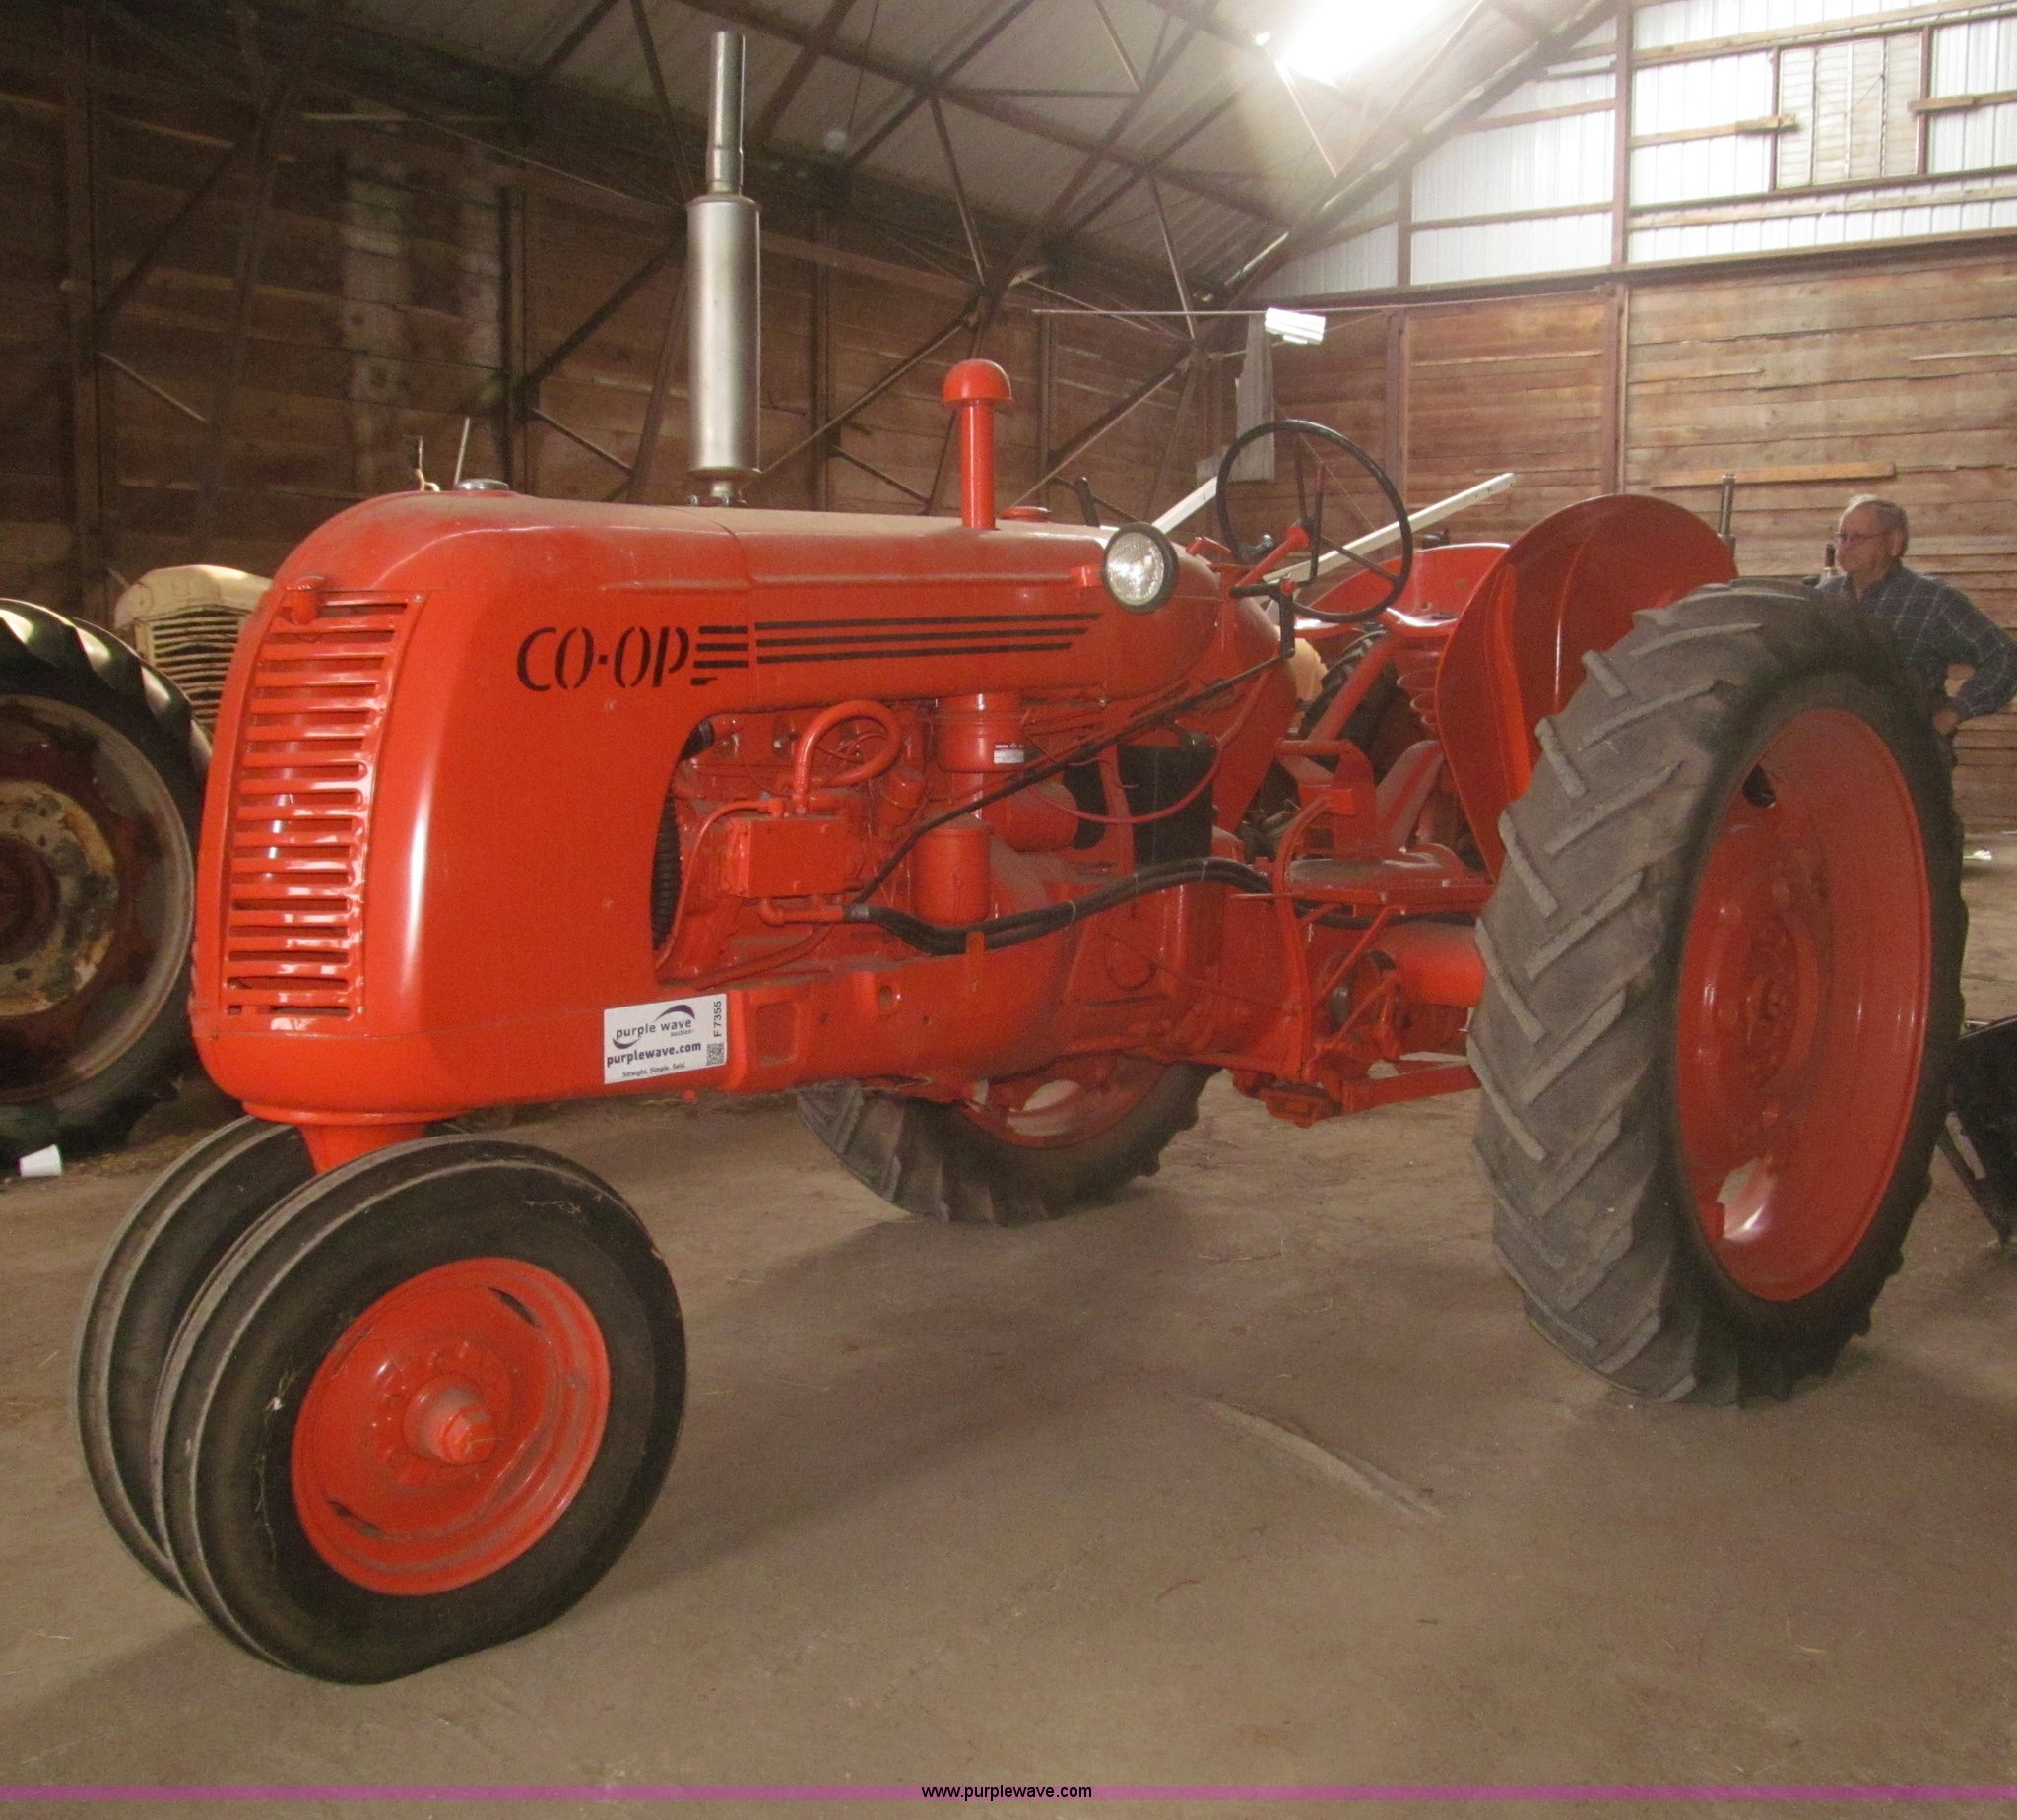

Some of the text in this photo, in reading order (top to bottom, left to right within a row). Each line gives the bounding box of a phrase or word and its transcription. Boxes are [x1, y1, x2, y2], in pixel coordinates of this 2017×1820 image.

[616, 1018, 692, 1040] purple wave
[607, 1042, 701, 1067] purplewave.com
